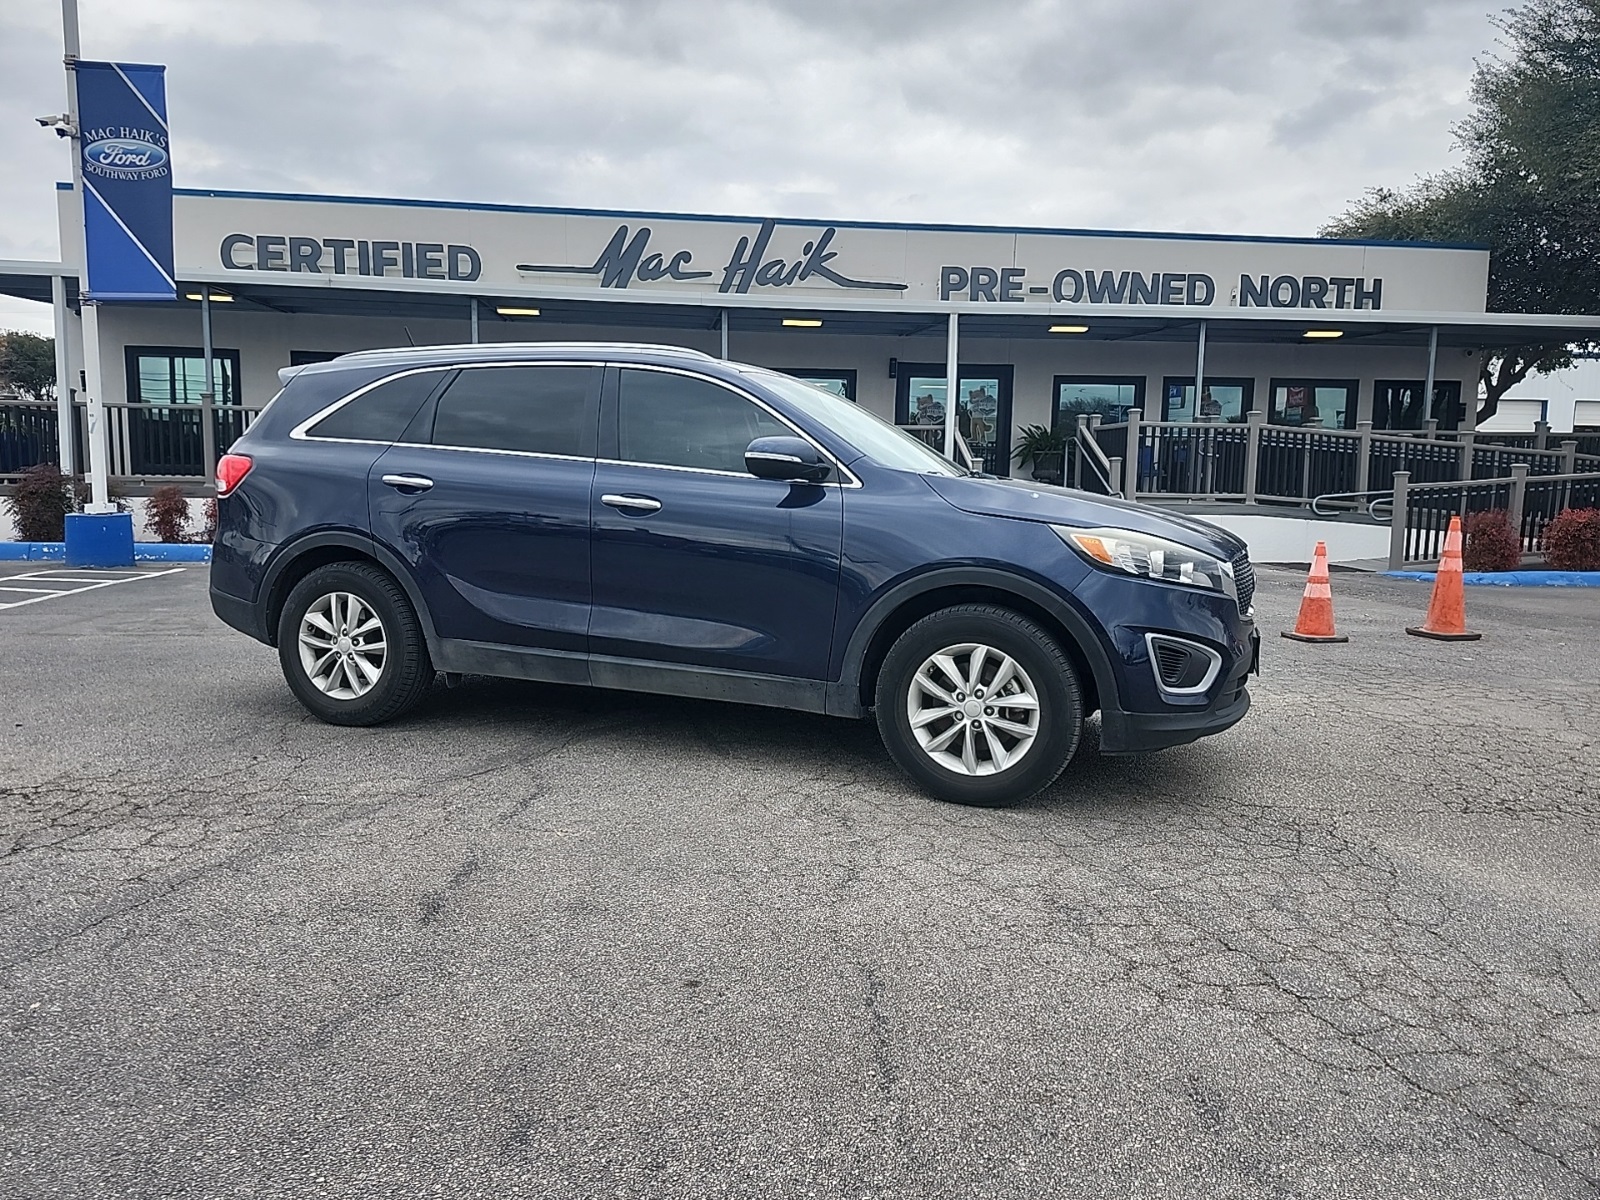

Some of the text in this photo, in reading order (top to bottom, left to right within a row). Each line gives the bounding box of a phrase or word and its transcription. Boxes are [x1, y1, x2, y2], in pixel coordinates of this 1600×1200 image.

[84, 126, 167, 148] MAC HAIK'S
[99, 143, 151, 166] Ford
[85, 163, 168, 180] SOUTHWAY FORD
[220, 218, 1382, 311] CERTIFIED Mac Haik PRE-OWNED NORTH
